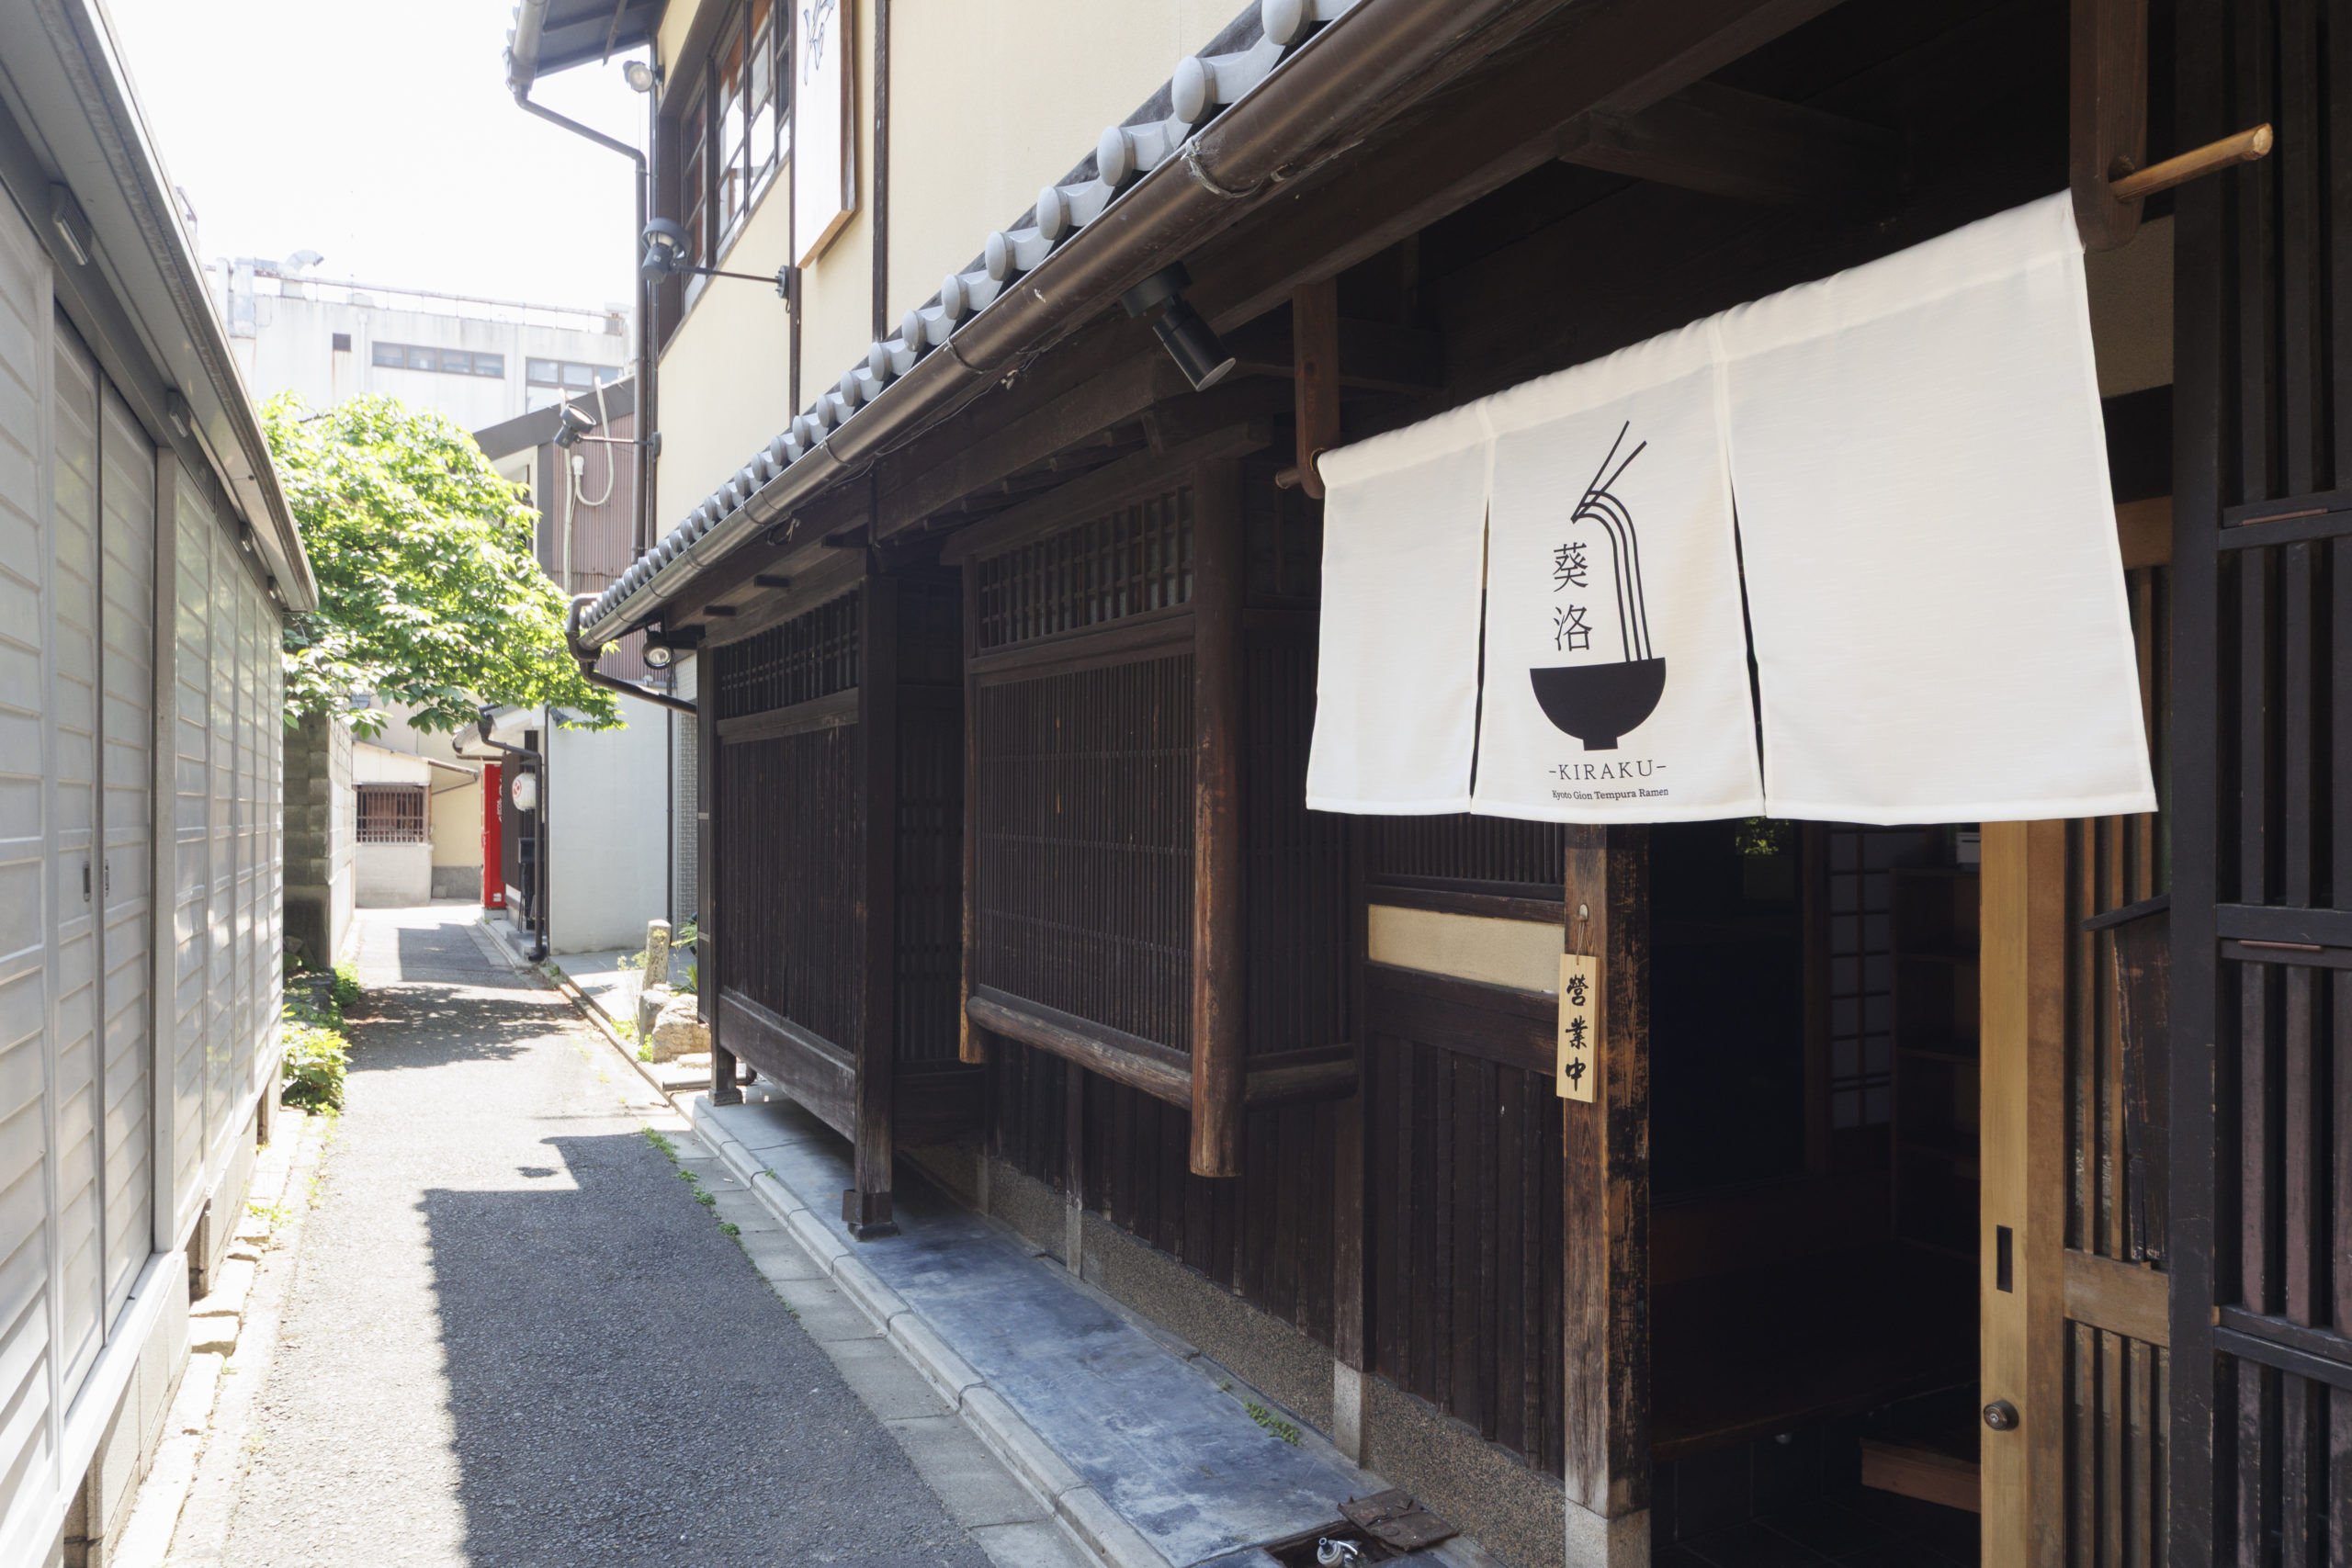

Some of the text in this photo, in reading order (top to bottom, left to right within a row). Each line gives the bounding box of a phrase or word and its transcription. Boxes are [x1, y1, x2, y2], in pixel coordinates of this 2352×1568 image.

[1553, 542, 1593, 651] 葵洛
[1552, 788, 1668, 801] Kyoto Gion Tempura Ramen
